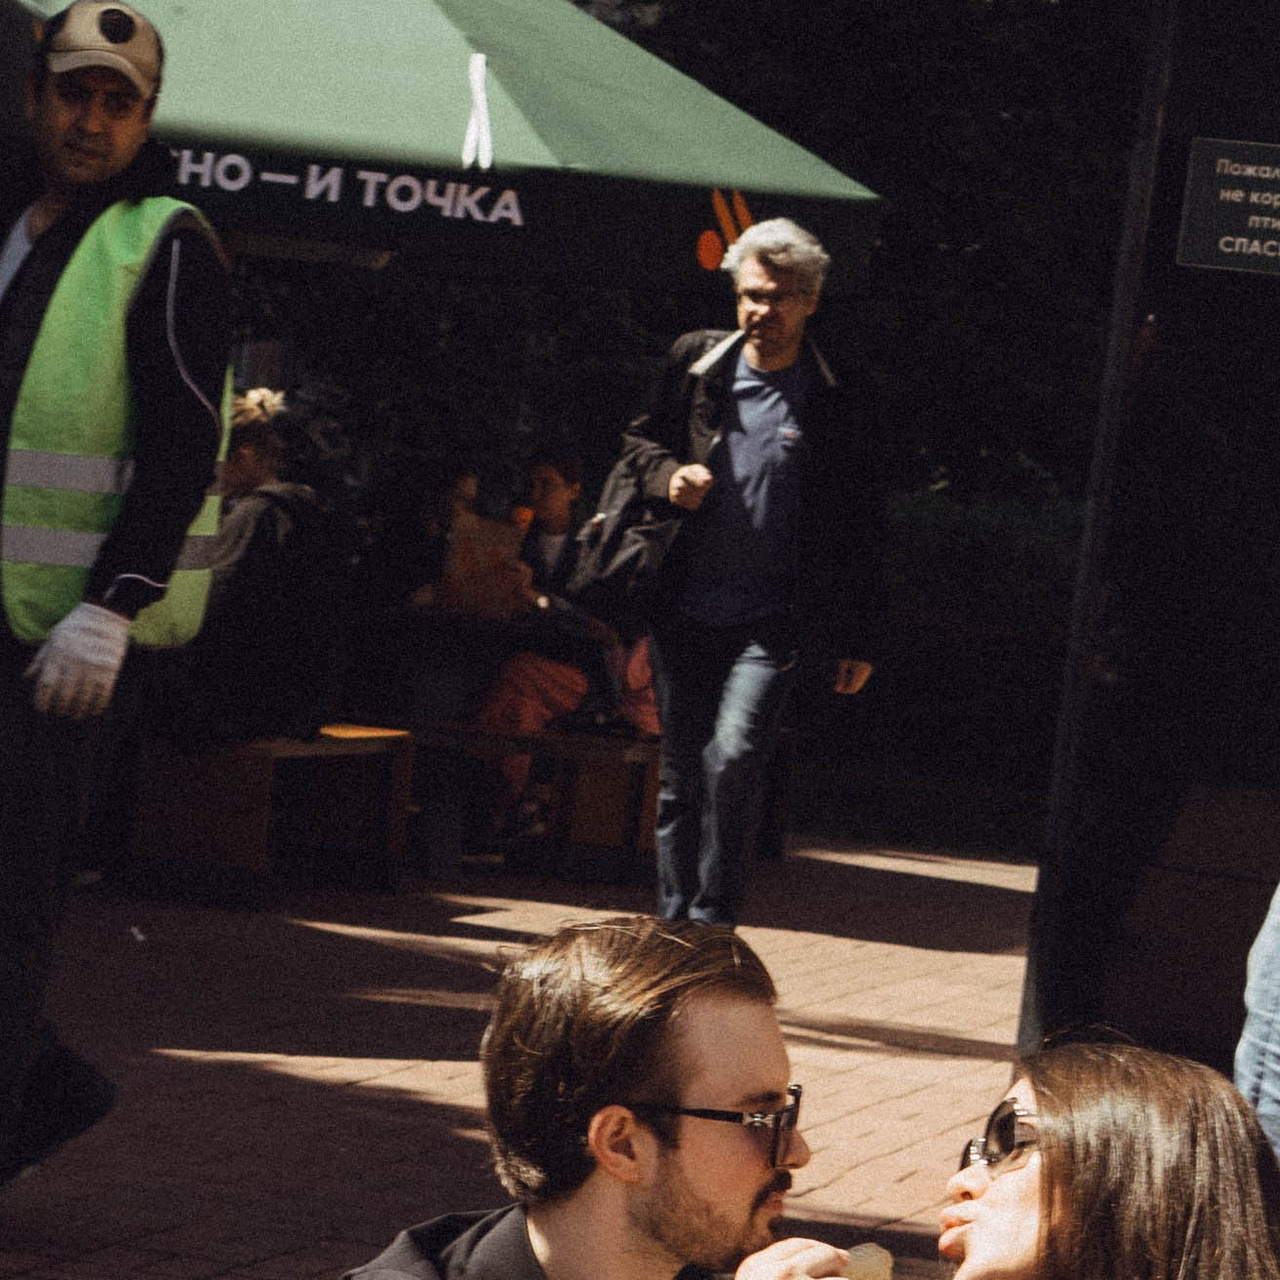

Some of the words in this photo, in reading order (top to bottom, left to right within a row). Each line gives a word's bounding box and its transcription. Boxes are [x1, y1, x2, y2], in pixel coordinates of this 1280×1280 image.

[357, 170, 524, 227] ТОЧКА
[1218, 188, 1246, 203] не
[1218, 235, 1280, 258] СПАС
